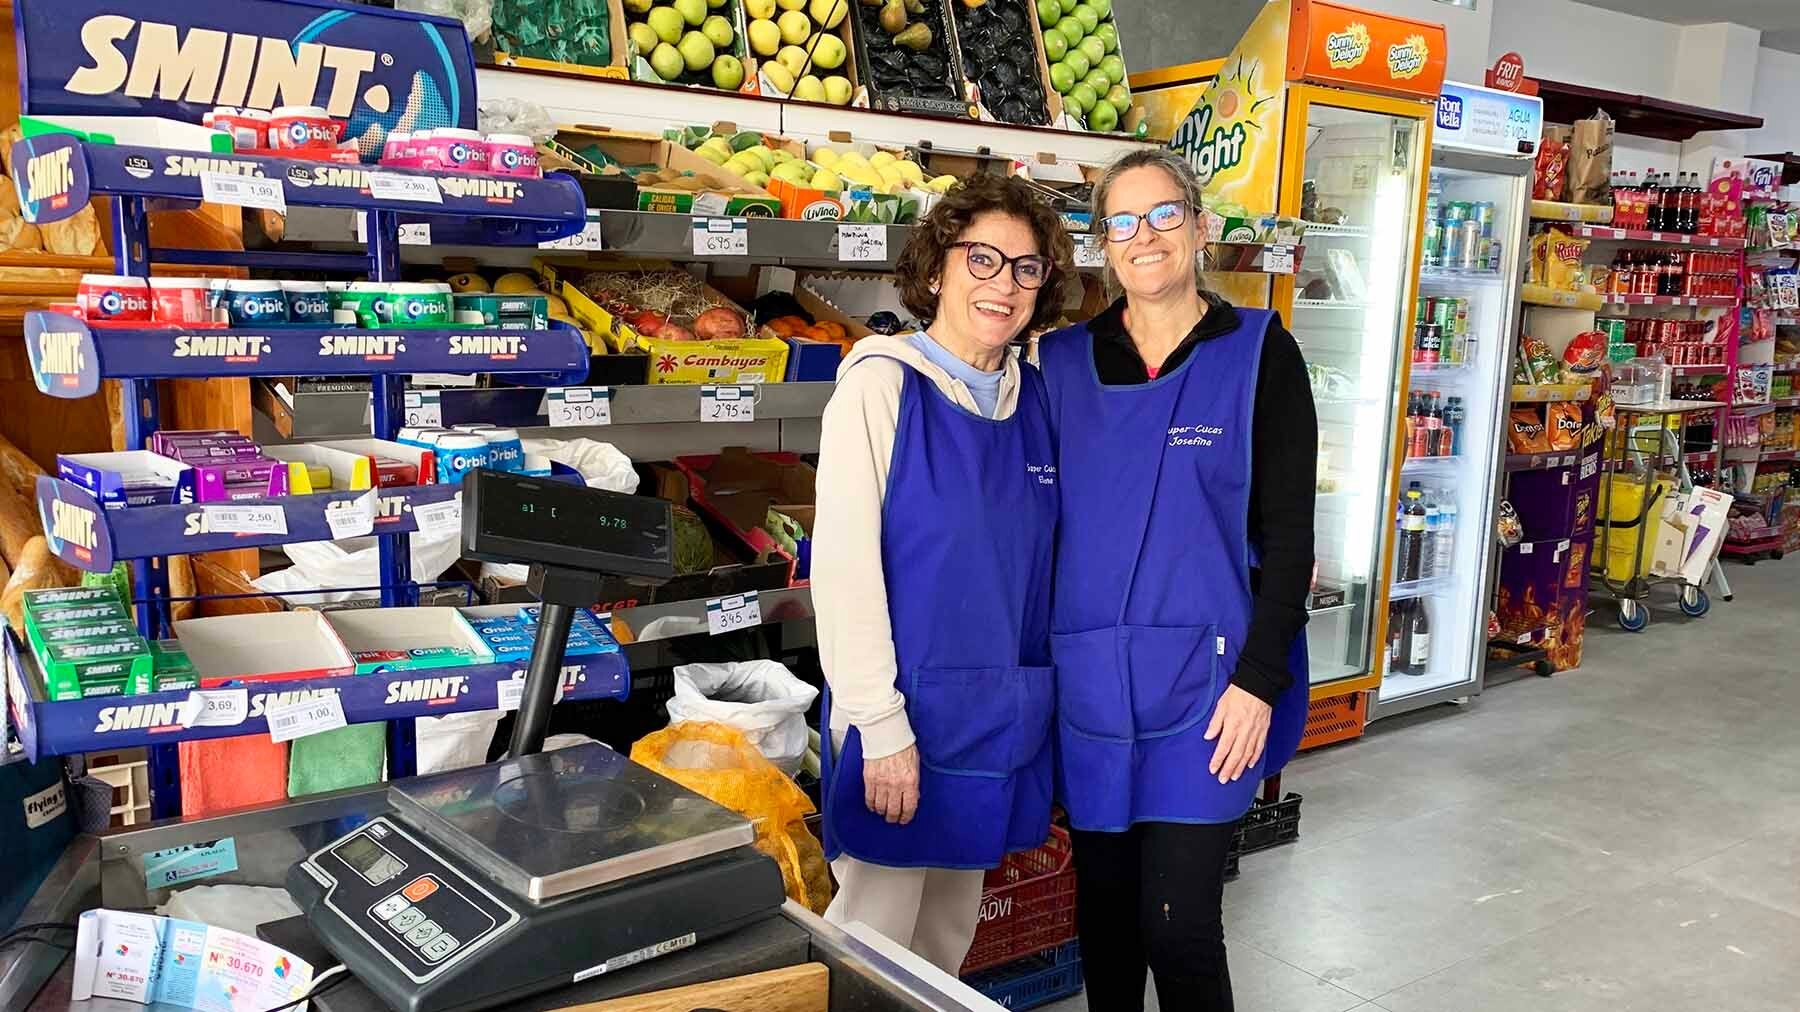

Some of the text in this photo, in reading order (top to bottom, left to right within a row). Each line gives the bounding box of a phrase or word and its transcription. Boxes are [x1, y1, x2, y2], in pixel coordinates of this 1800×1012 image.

[1329, 34, 1353, 50] Sunny
[1333, 46, 1364, 62] Delight
[1390, 46, 1413, 60] Sunny
[1392, 56, 1422, 72] Delight
[1496, 61, 1521, 80] FRIT
[1440, 96, 1461, 112] Font
[1439, 111, 1460, 128] Vella
[1508, 109, 1530, 123] AGUA
[288, 121, 332, 144] Orbit
[449, 142, 486, 165] Orbit
[501, 147, 538, 170] Orbit
[652, 194, 676, 204] CALIDAD
[102, 290, 147, 316] Orbit
[242, 297, 284, 319] Orbit
[294, 296, 329, 317] Orbit
[408, 299, 446, 319] Orbit
[683, 354, 768, 370] Cambayas
[317, 384, 354, 392] PREMIUM
[1169, 436, 1213, 447] Josefina
[453, 454, 487, 471] Orbit
[489, 448, 518, 464] Orbit
[226, 956, 264, 978] 30.670
